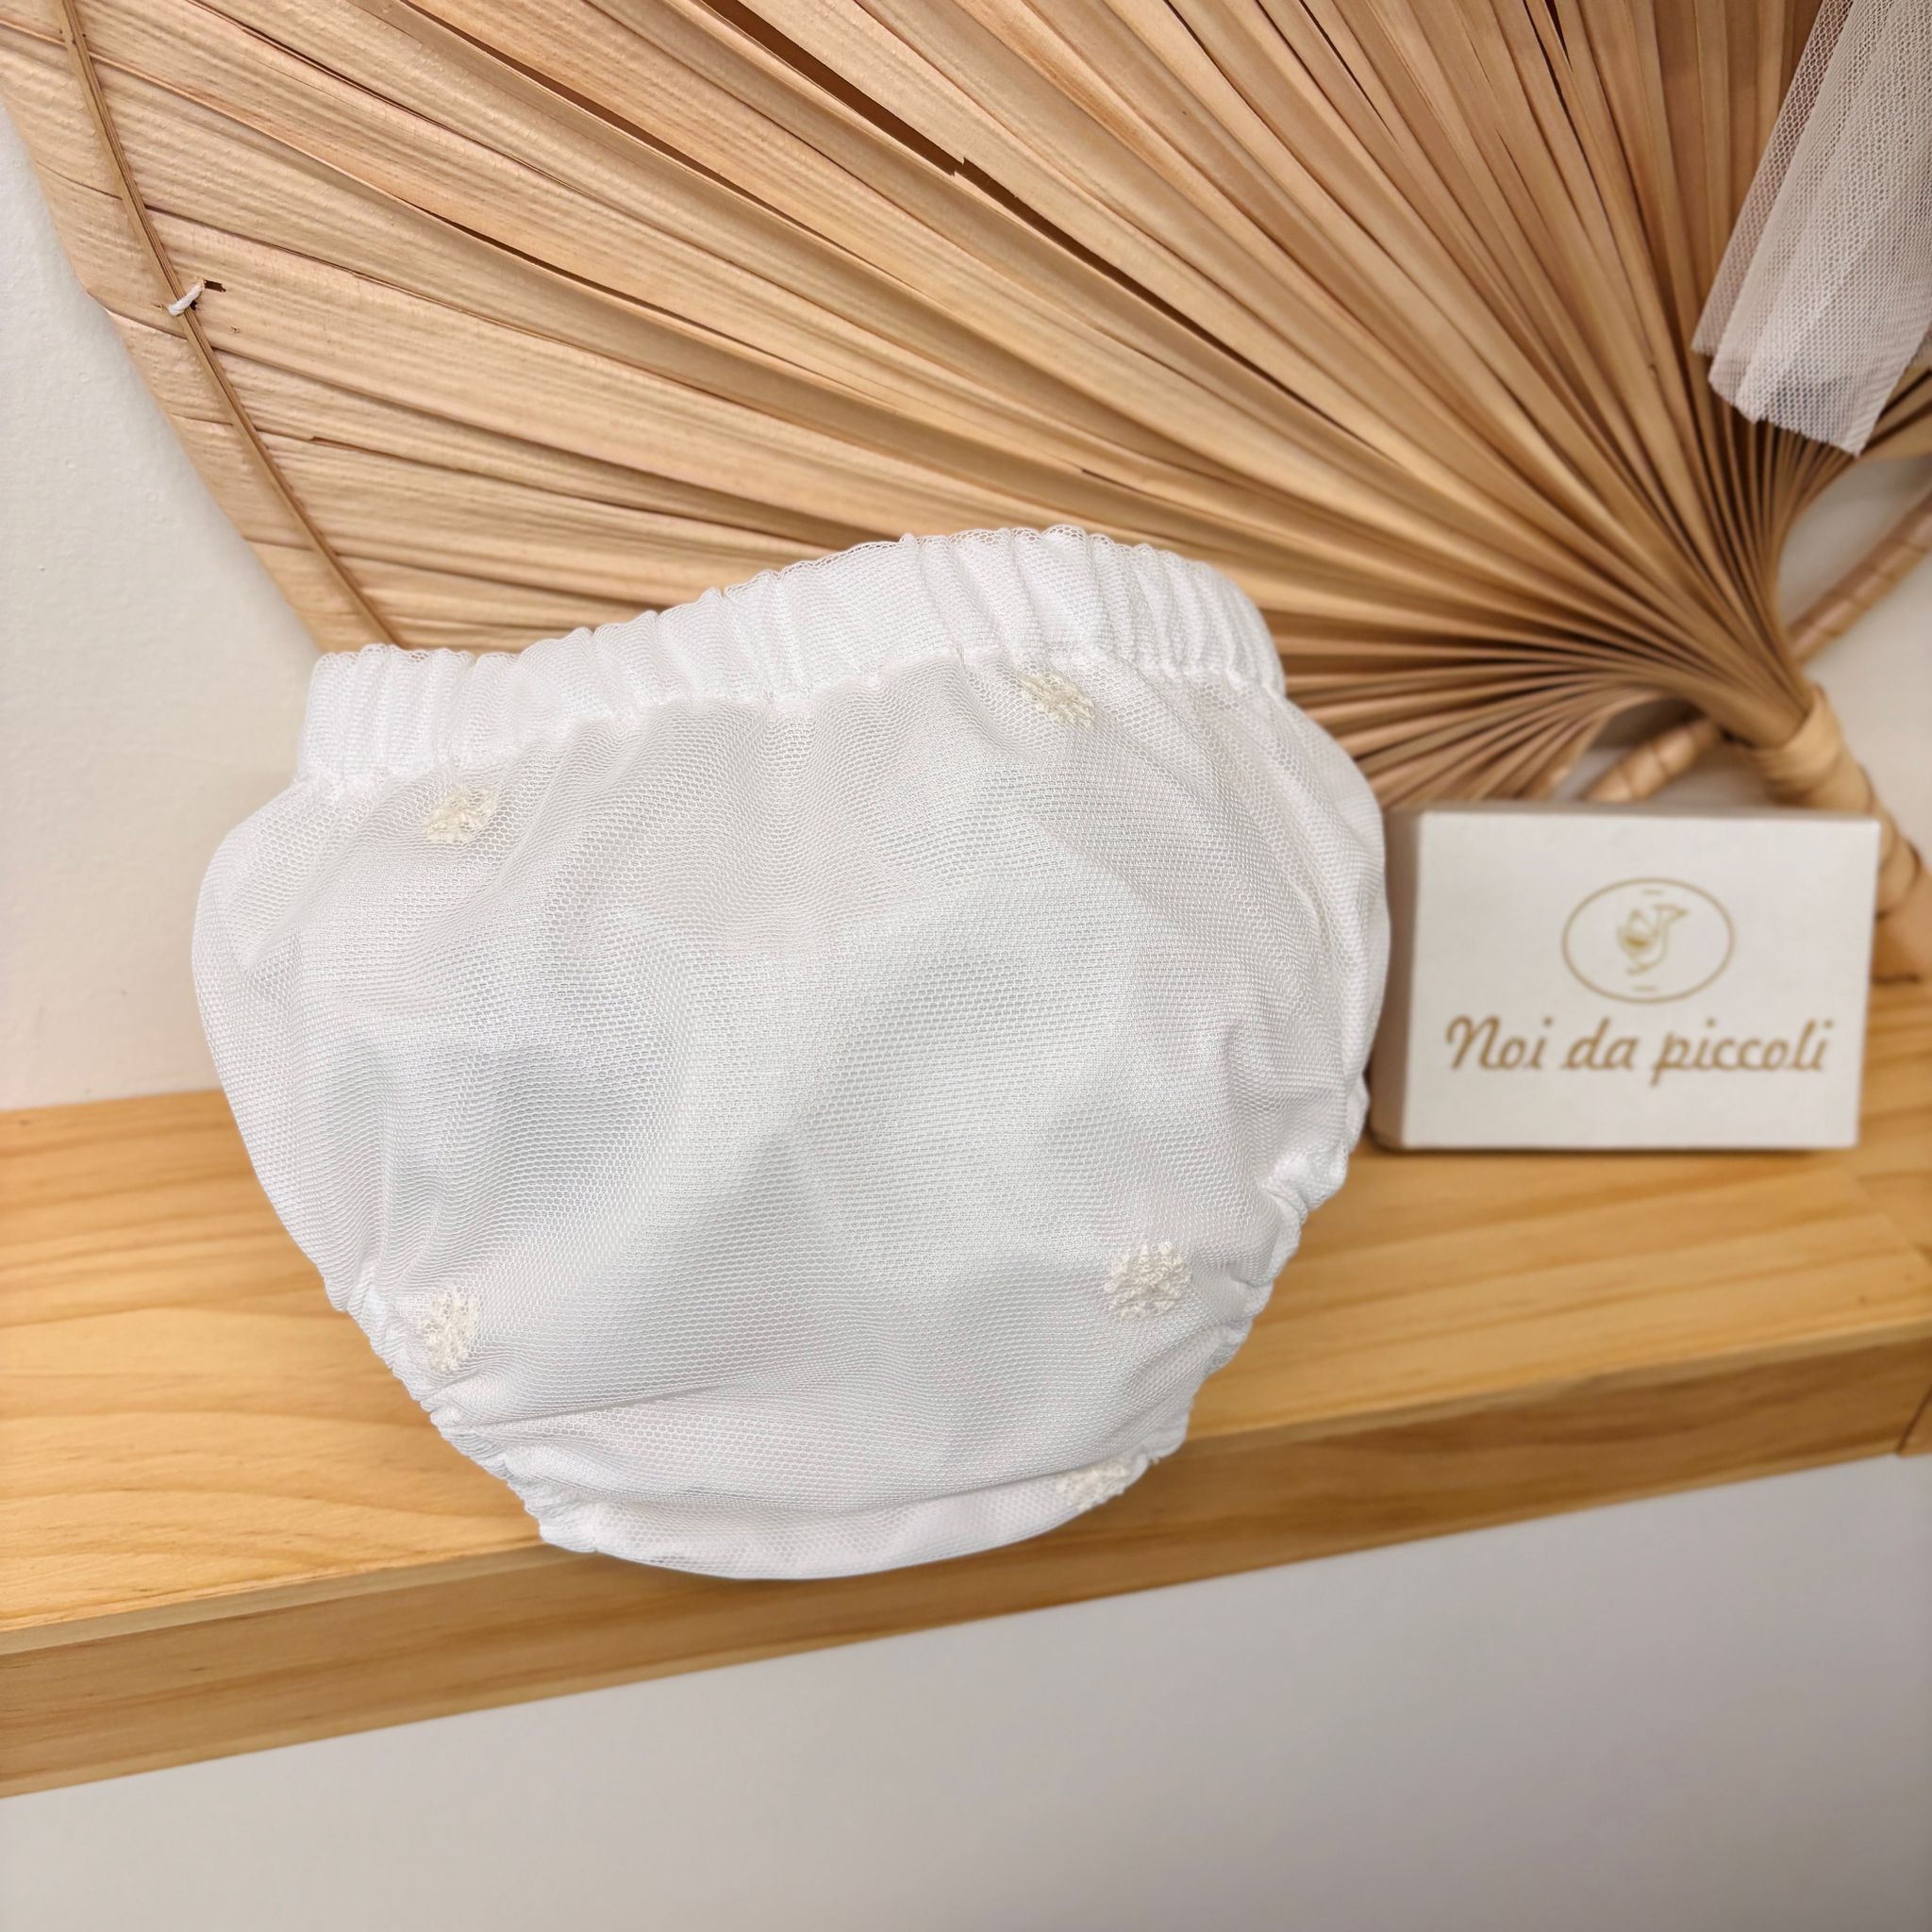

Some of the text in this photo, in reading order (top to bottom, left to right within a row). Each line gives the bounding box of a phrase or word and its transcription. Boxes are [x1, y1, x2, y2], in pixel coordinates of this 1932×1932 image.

[1445, 1015, 1834, 1087] Noi da piccoli
